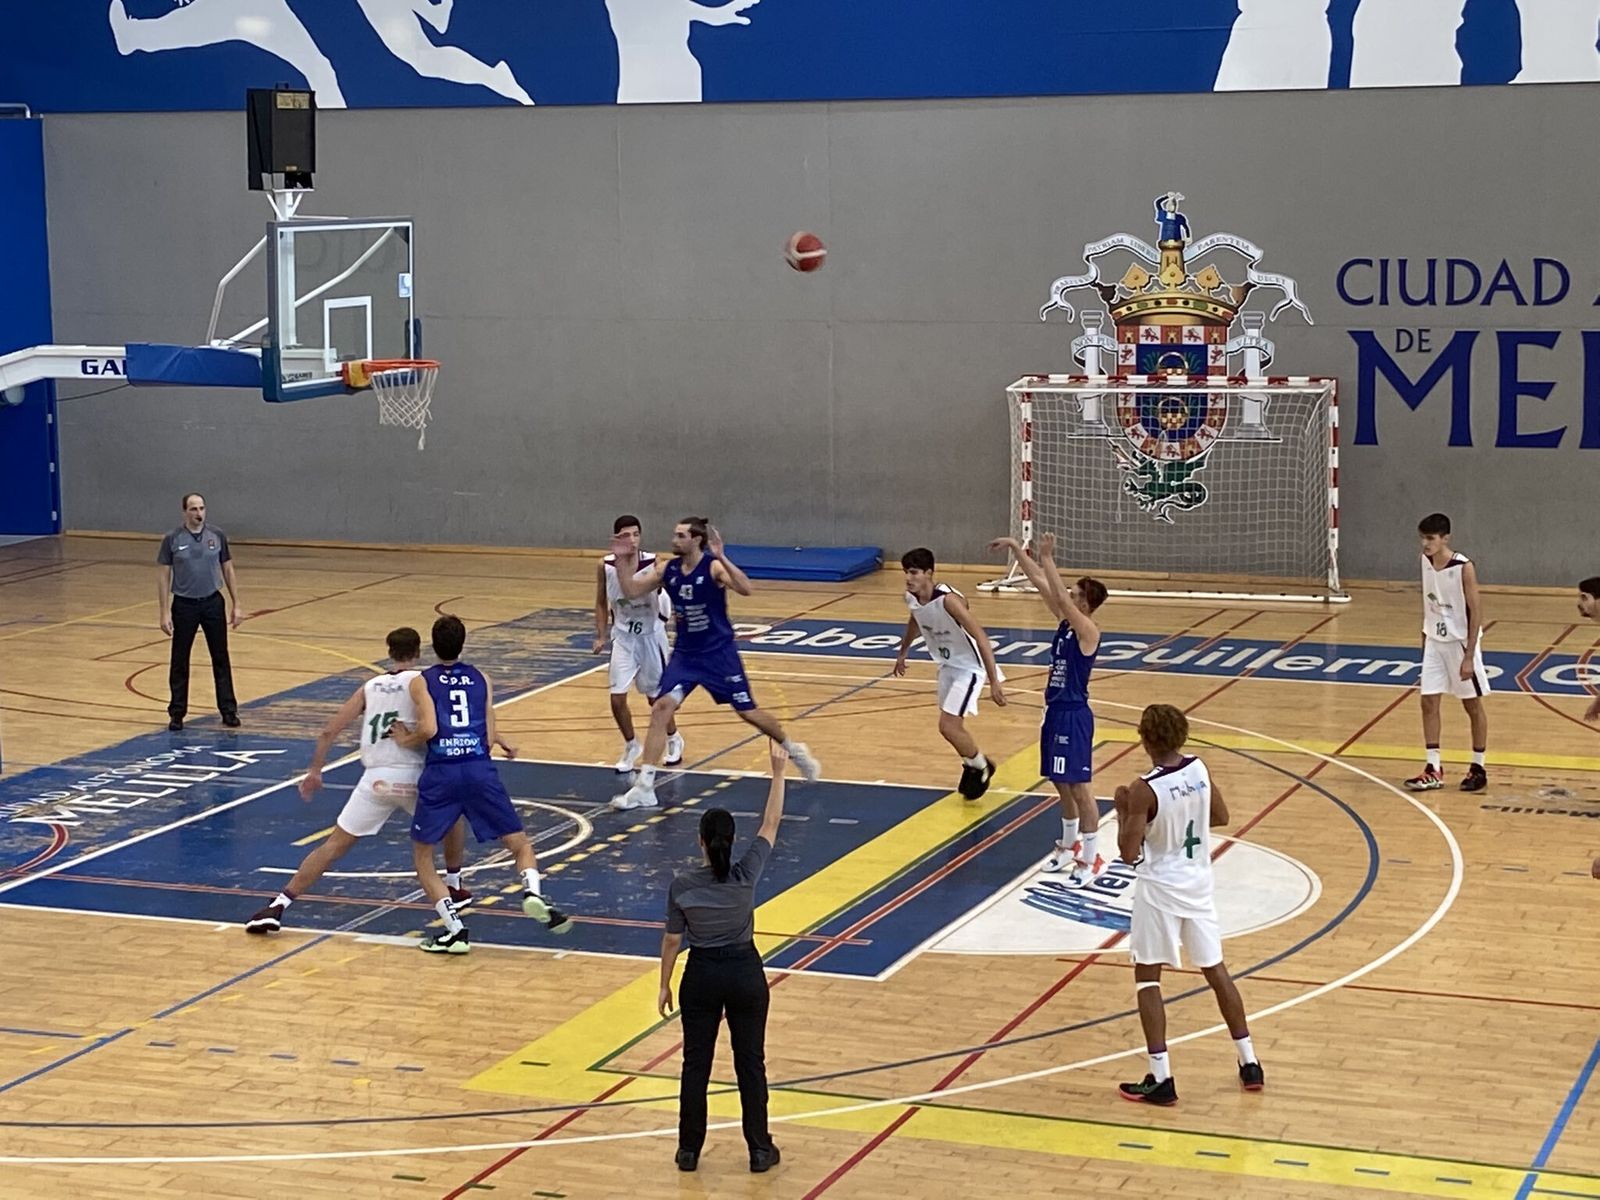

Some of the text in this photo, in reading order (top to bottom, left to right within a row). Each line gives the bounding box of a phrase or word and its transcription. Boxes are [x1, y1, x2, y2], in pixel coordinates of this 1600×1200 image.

[1336, 257, 1571, 307] CIUDAD
[1395, 328, 1433, 353] DE
[81, 358, 127, 376] GA
[627, 620, 643, 635] 16
[449, 689, 470, 728] 3
[368, 710, 399, 745] 15
[1053, 755, 1066, 775] 10
[7, 749, 289, 827] MELILLA
[1183, 819, 1201, 859] 4
